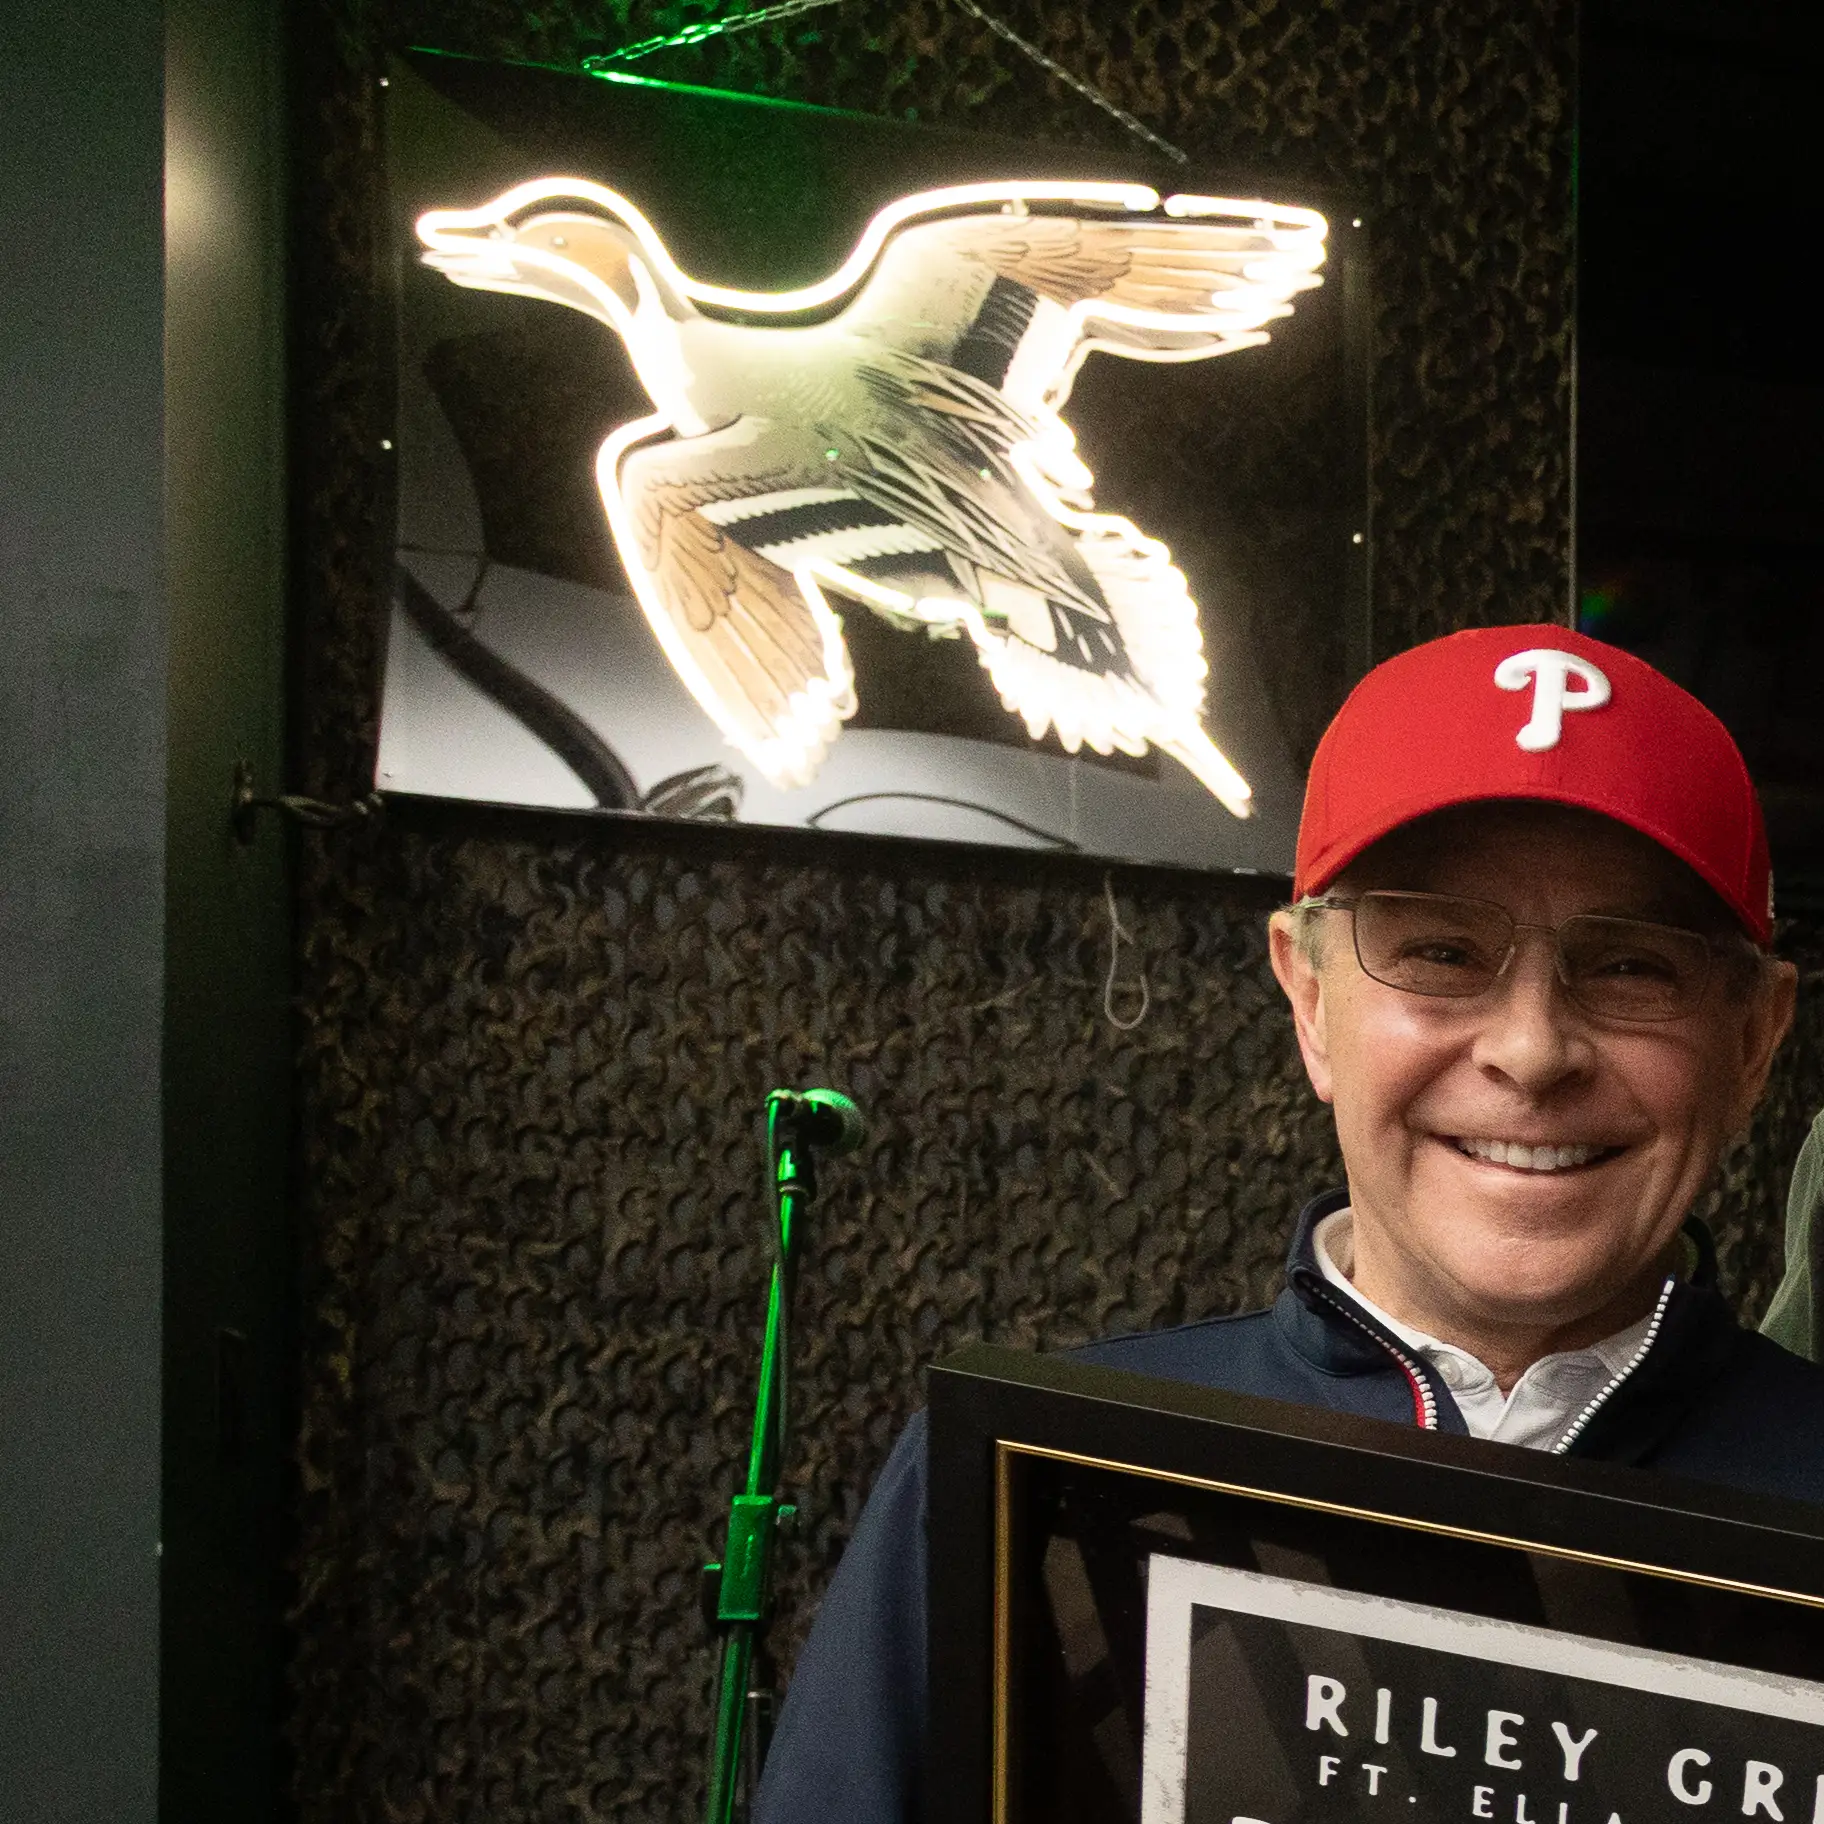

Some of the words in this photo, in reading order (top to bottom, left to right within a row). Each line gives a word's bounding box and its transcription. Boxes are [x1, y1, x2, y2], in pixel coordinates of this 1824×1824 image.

[1494, 649, 1612, 753] P
[1305, 1674, 1598, 1782] RILEY
[1319, 1755, 1417, 1803] FT.
